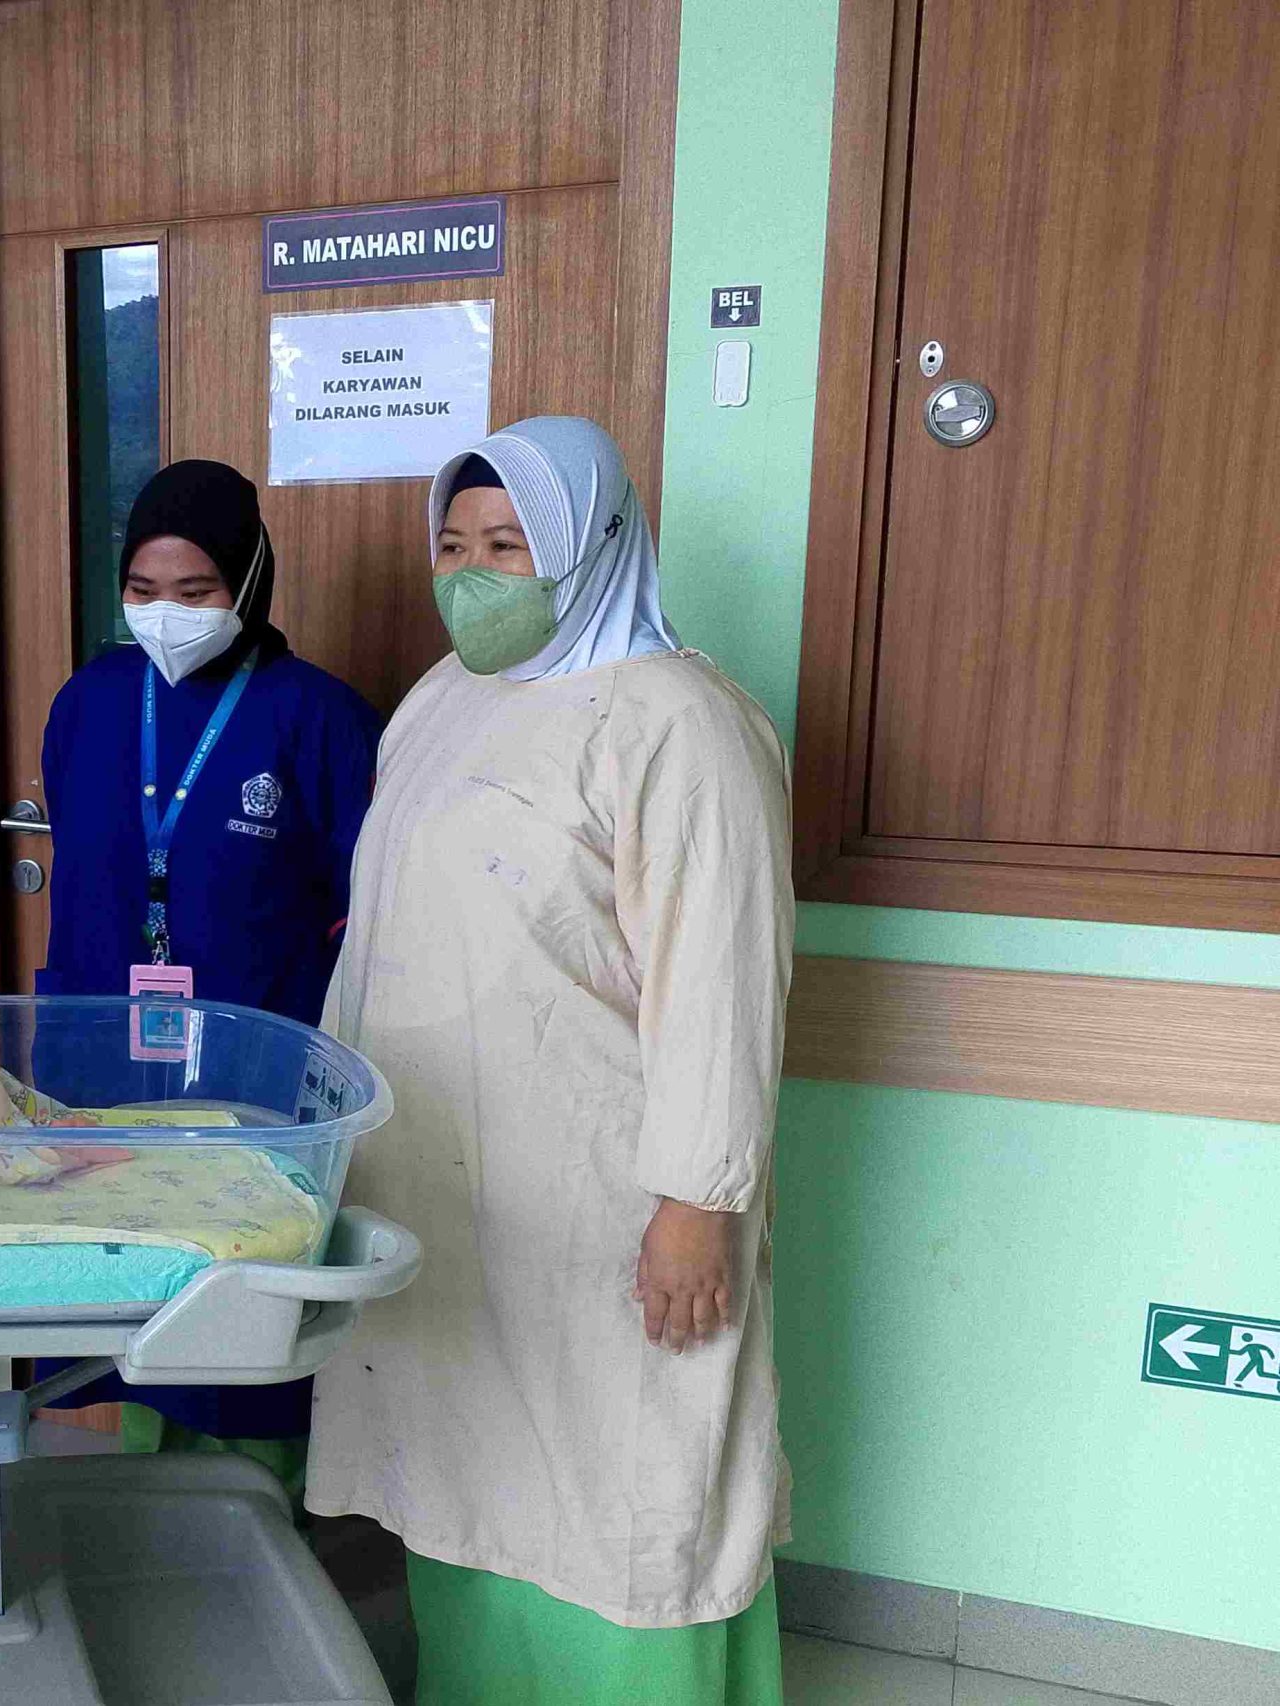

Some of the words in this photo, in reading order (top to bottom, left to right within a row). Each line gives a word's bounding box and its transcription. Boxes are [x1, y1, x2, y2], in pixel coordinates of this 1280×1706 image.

[273, 242, 295, 266] R.
[303, 230, 425, 264] MATAHARI
[434, 224, 495, 253] NICU
[718, 291, 754, 308] BEL
[341, 348, 404, 365] SELAIN
[323, 376, 422, 394] KARYAWAN
[295, 404, 381, 421] DILARANG
[387, 401, 451, 417] MASUK
[183, 753, 204, 786] DOKTER
[200, 729, 217, 752] MUDA
